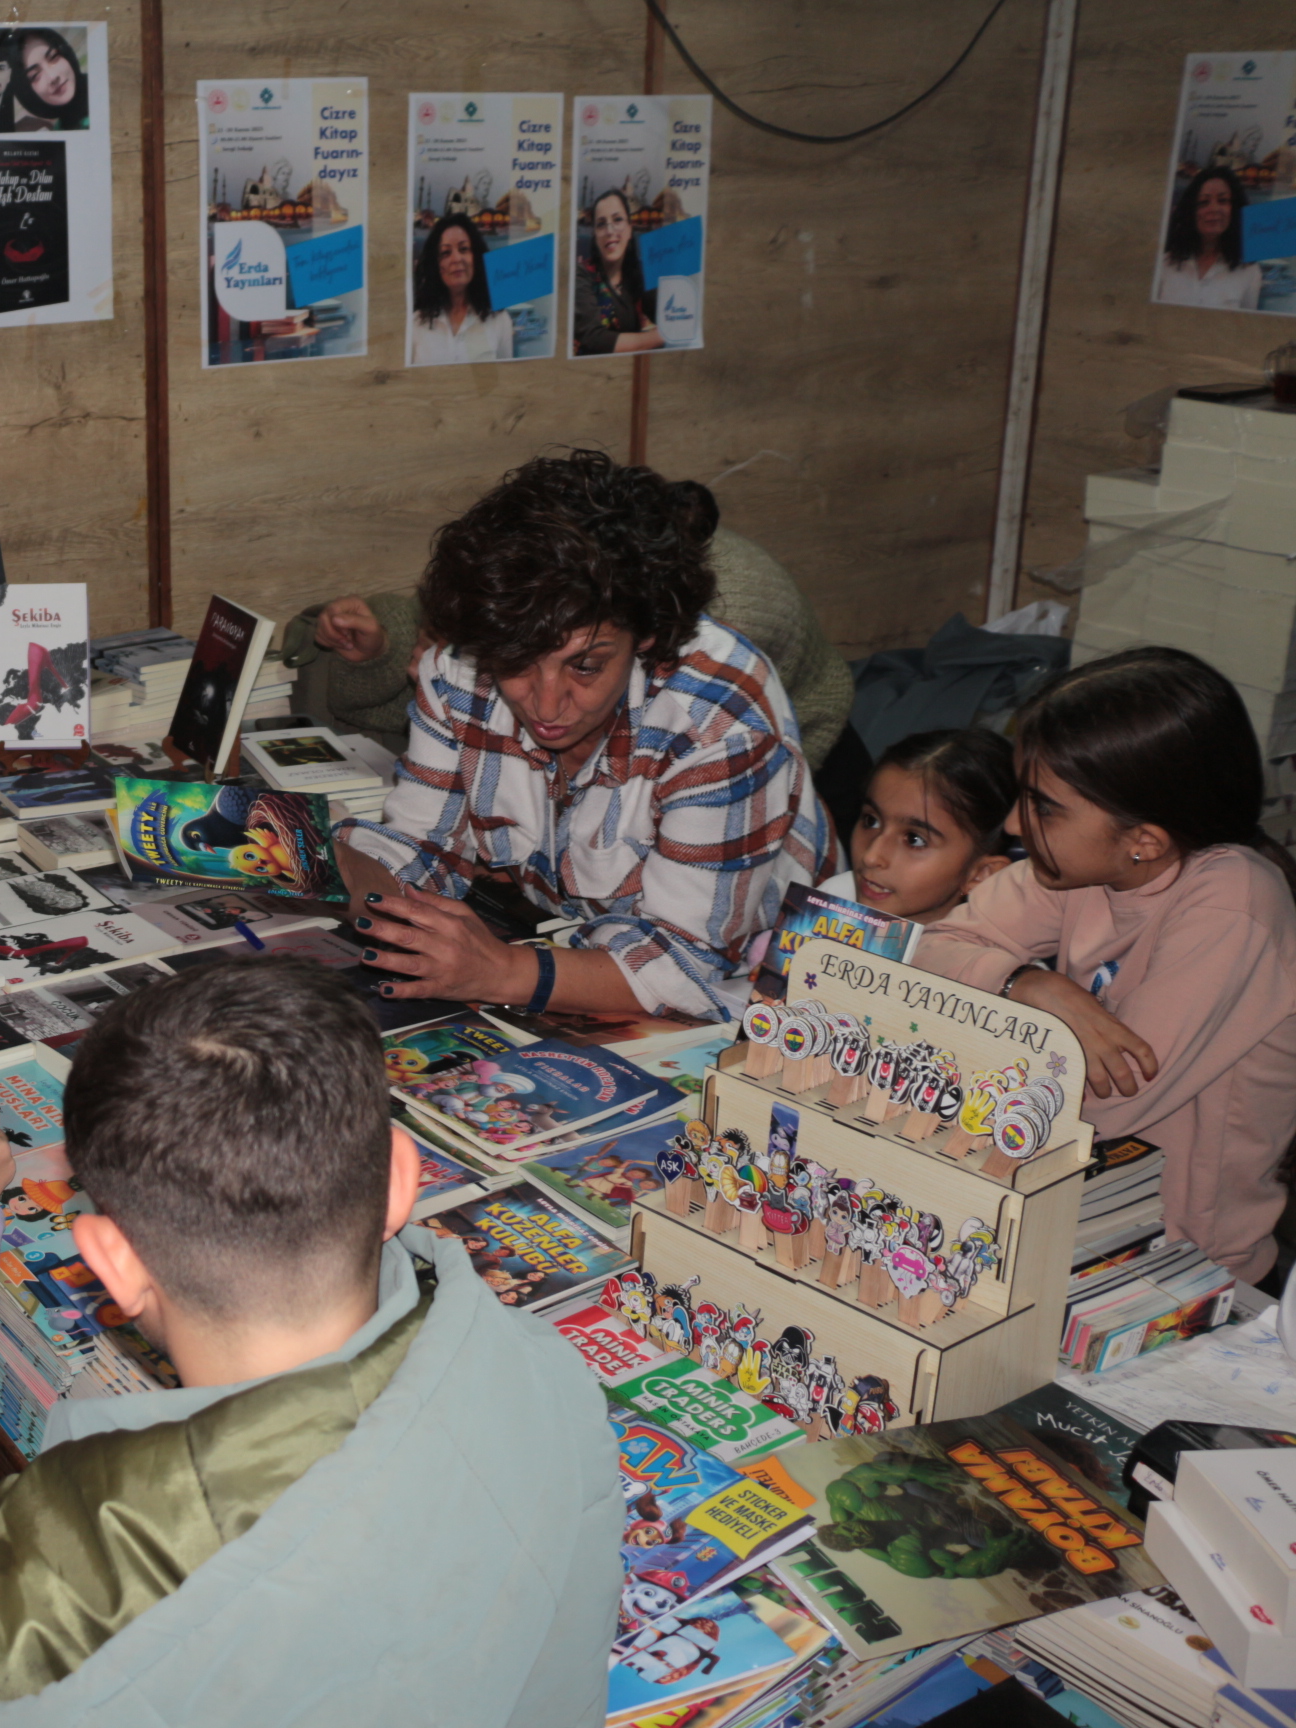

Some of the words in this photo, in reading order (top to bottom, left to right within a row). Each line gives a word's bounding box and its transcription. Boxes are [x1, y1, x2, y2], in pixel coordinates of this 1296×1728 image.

[320, 106, 357, 120] Cizre
[319, 126, 358, 143] Kitap
[519, 120, 552, 133] Cizre
[673, 121, 702, 133] Cizre
[314, 147, 364, 160] Fuarın-
[517, 139, 553, 155] Kitap
[671, 139, 702, 154] Kitap
[318, 164, 359, 182] dayız
[512, 158, 557, 170] Fuarın-
[29, 169, 53, 185] Dilan
[515, 176, 552, 192] dayız
[669, 175, 701, 190] dayız
[15, 185, 53, 203] Destanı
[239, 262, 270, 274] Erda
[224, 276, 283, 290] Yayınları
[139, 812, 166, 868] TWEETY
[155, 877, 184, 887] TWEETY
[812, 915, 866, 950] ALFA
[820, 953, 892, 997] ERDA
[897, 980, 1054, 1055] YAYINLARI
[661, 1160, 680, 1174] AŞK
[483, 1202, 589, 1275] KUZENLER
[527, 1213, 584, 1249] ALFA
[473, 1217, 561, 1275] KULÜBÜ
[652, 1381, 738, 1436] TRADERS
[681, 1379, 744, 1421] MİNİK
[1036, 1411, 1110, 1445] Mucit
[1065, 1400, 1117, 1435] YETKİN
[732, 1428, 783, 1455] BAHÇEDE-3
[1257, 1469, 1281, 1490] ÖMER
[738, 1489, 788, 1522] STICKER
[946, 1438, 1120, 1576] BOYAMA
[994, 1445, 1145, 1550] KİTABI
[705, 1505, 762, 1541] HEDİYELİ
[718, 1495, 736, 1511] VE
[734, 1505, 780, 1533] MASKE
[1128, 1601, 1185, 1636] SİNANOĞLU
